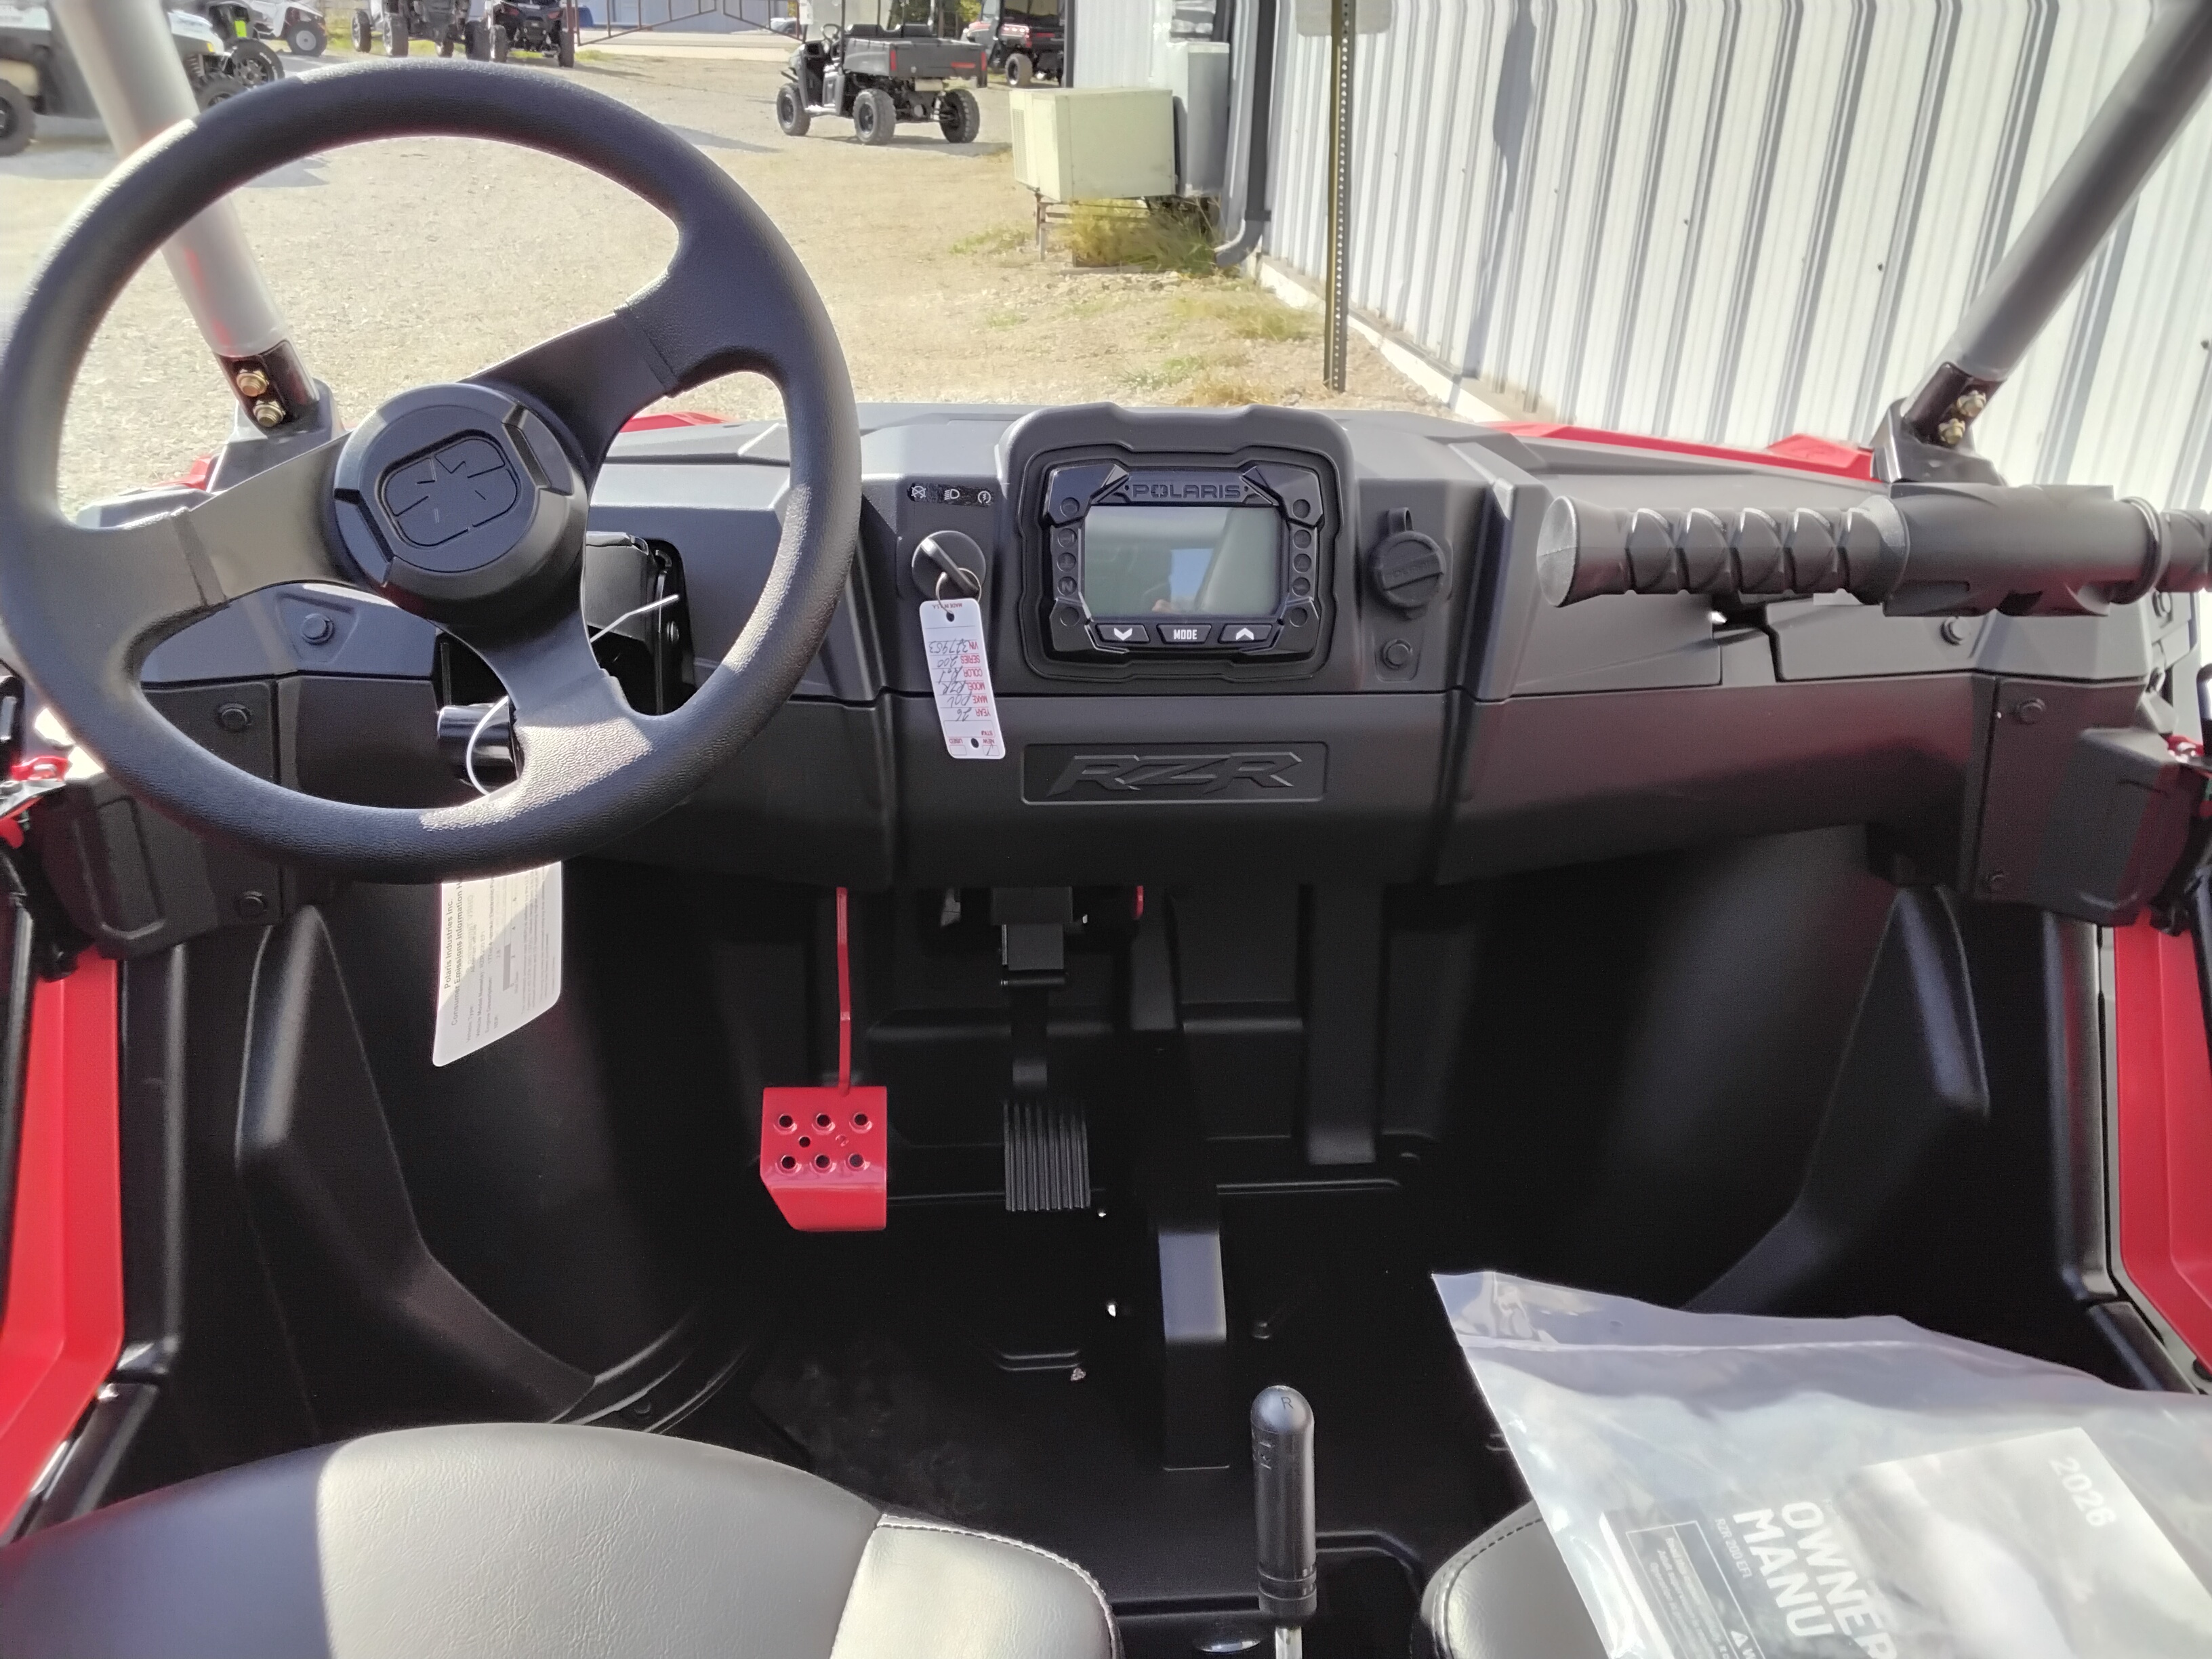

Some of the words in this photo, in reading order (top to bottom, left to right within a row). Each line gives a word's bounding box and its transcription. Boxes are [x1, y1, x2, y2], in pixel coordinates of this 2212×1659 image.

[1132, 483, 1241, 499] POLARIS
[1061, 581, 1073, 593] N
[1173, 629, 1197, 640] MODE
[969, 641, 979, 650] VIN
[937, 655, 958, 668] 200
[960, 655, 980, 664] SERIES
[964, 668, 983, 678] COLOR
[965, 682, 985, 691] MODEL
[973, 695, 987, 703] MAKE
[976, 709, 990, 717] YEAR
[1046, 752, 1303, 797] RZR
[454, 941, 463, 984] Emissions
[451, 985, 460, 1026] Consumer
[1281, 1396, 1294, 1410] R
[2049, 1456, 2117, 1527] 2026
[1715, 1518, 1732, 1538] RZR
[1725, 1539, 1743, 1559] 200
[1736, 1561, 1753, 1578] EFI
